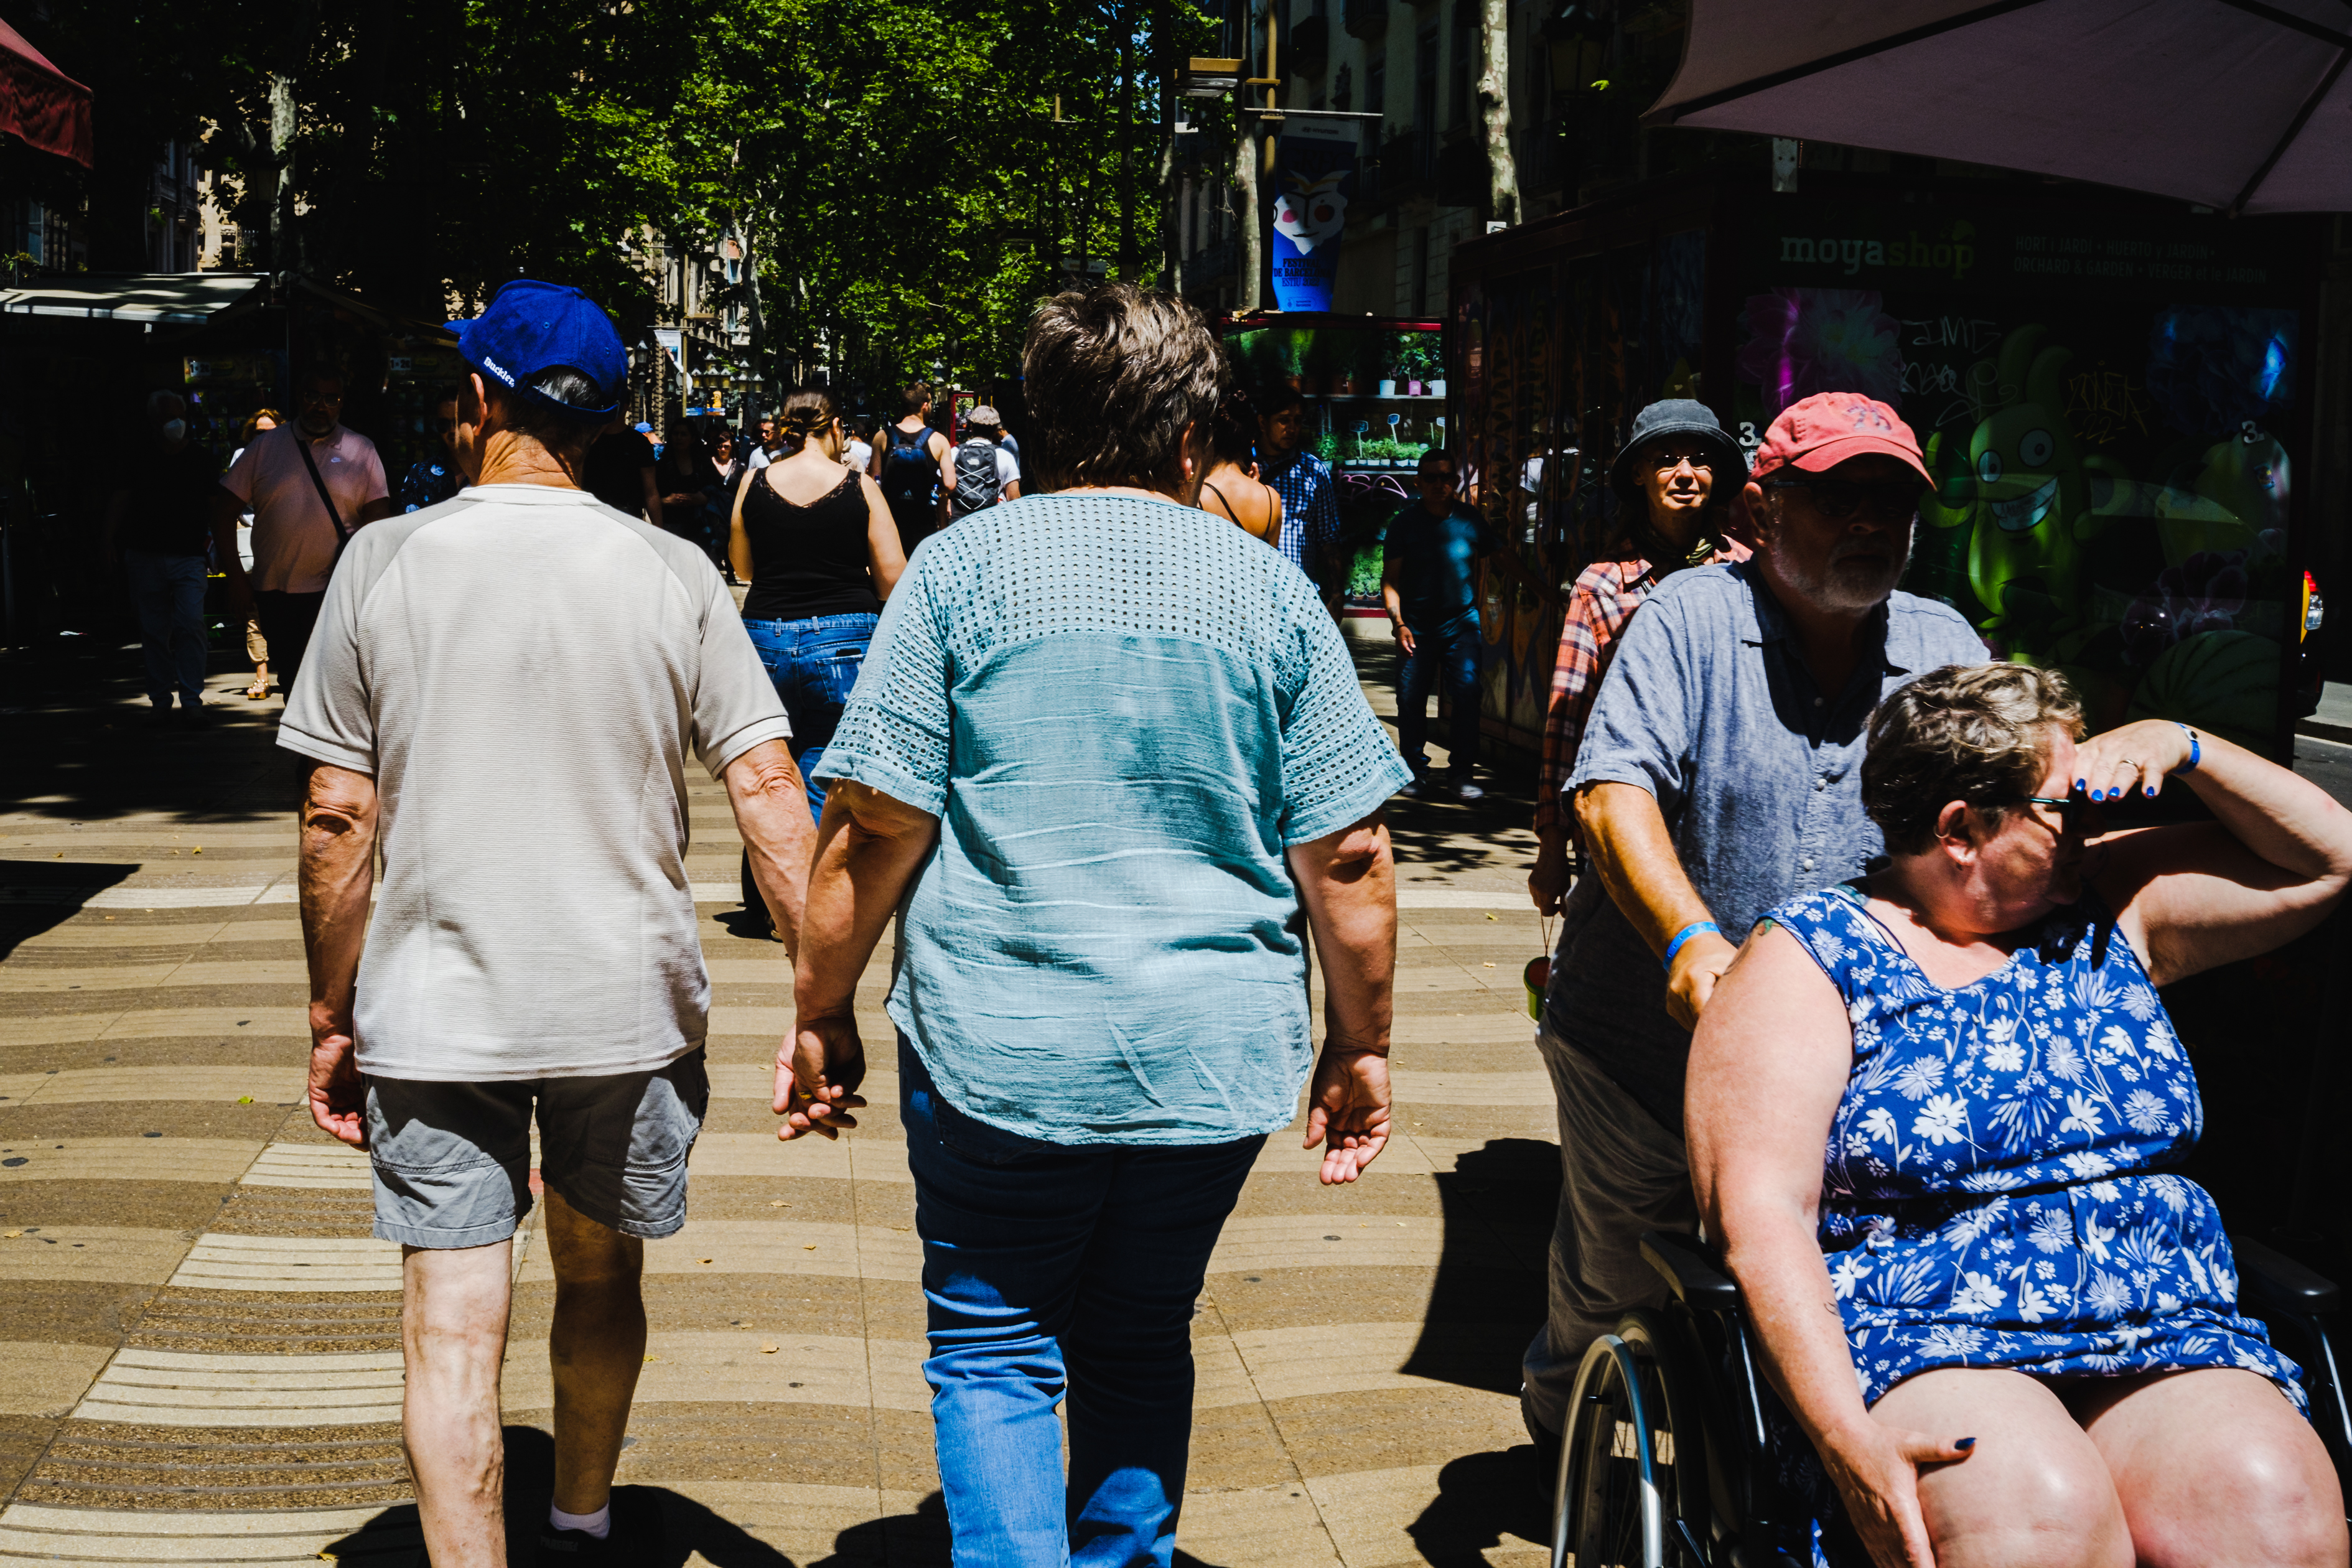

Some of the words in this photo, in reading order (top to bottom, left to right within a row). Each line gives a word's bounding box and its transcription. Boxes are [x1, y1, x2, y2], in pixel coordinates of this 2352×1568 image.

[1780, 230, 1975, 280] moyashop
[2015, 235, 2047, 252] HORT
[2058, 235, 2093, 254] JARDÍ
[2106, 240, 2152, 258] HUERTO
[2165, 241, 2208, 260] JARDÍN
[1282, 258, 1320, 268] FESTIVAL
[2014, 256, 2070, 274] ORCHARD
[2073, 259, 2082, 275] &
[2086, 259, 2134, 278] GARDEN
[2147, 263, 2193, 281] VERGER
[2196, 266, 2207, 281] et
[2211, 264, 2222, 282] le
[2224, 267, 2267, 284] JARDIN
[1273, 268, 1282, 277] DE
[1284, 268, 1331, 278] BARCELONA
[1282, 278, 1300, 287] ESTIU
